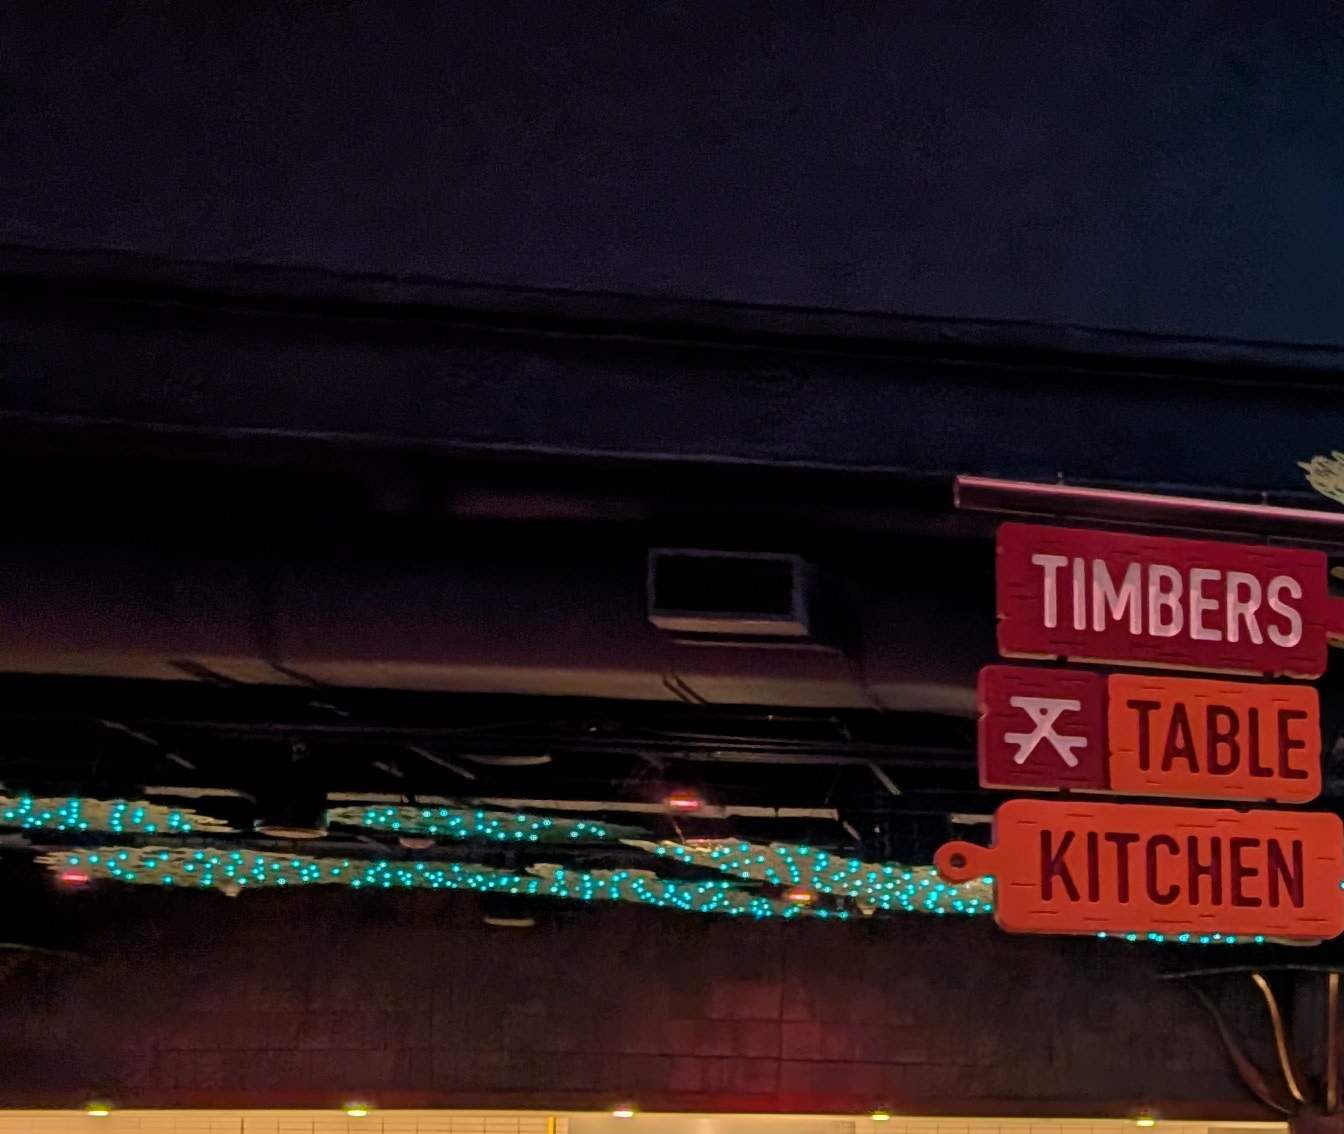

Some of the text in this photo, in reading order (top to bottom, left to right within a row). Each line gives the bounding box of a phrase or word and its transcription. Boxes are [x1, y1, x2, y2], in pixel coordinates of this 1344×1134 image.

[1032, 554, 1304, 648] TIMBERS
[1127, 699, 1309, 780] TABLE
[1040, 829, 1305, 908] KITCHEN
